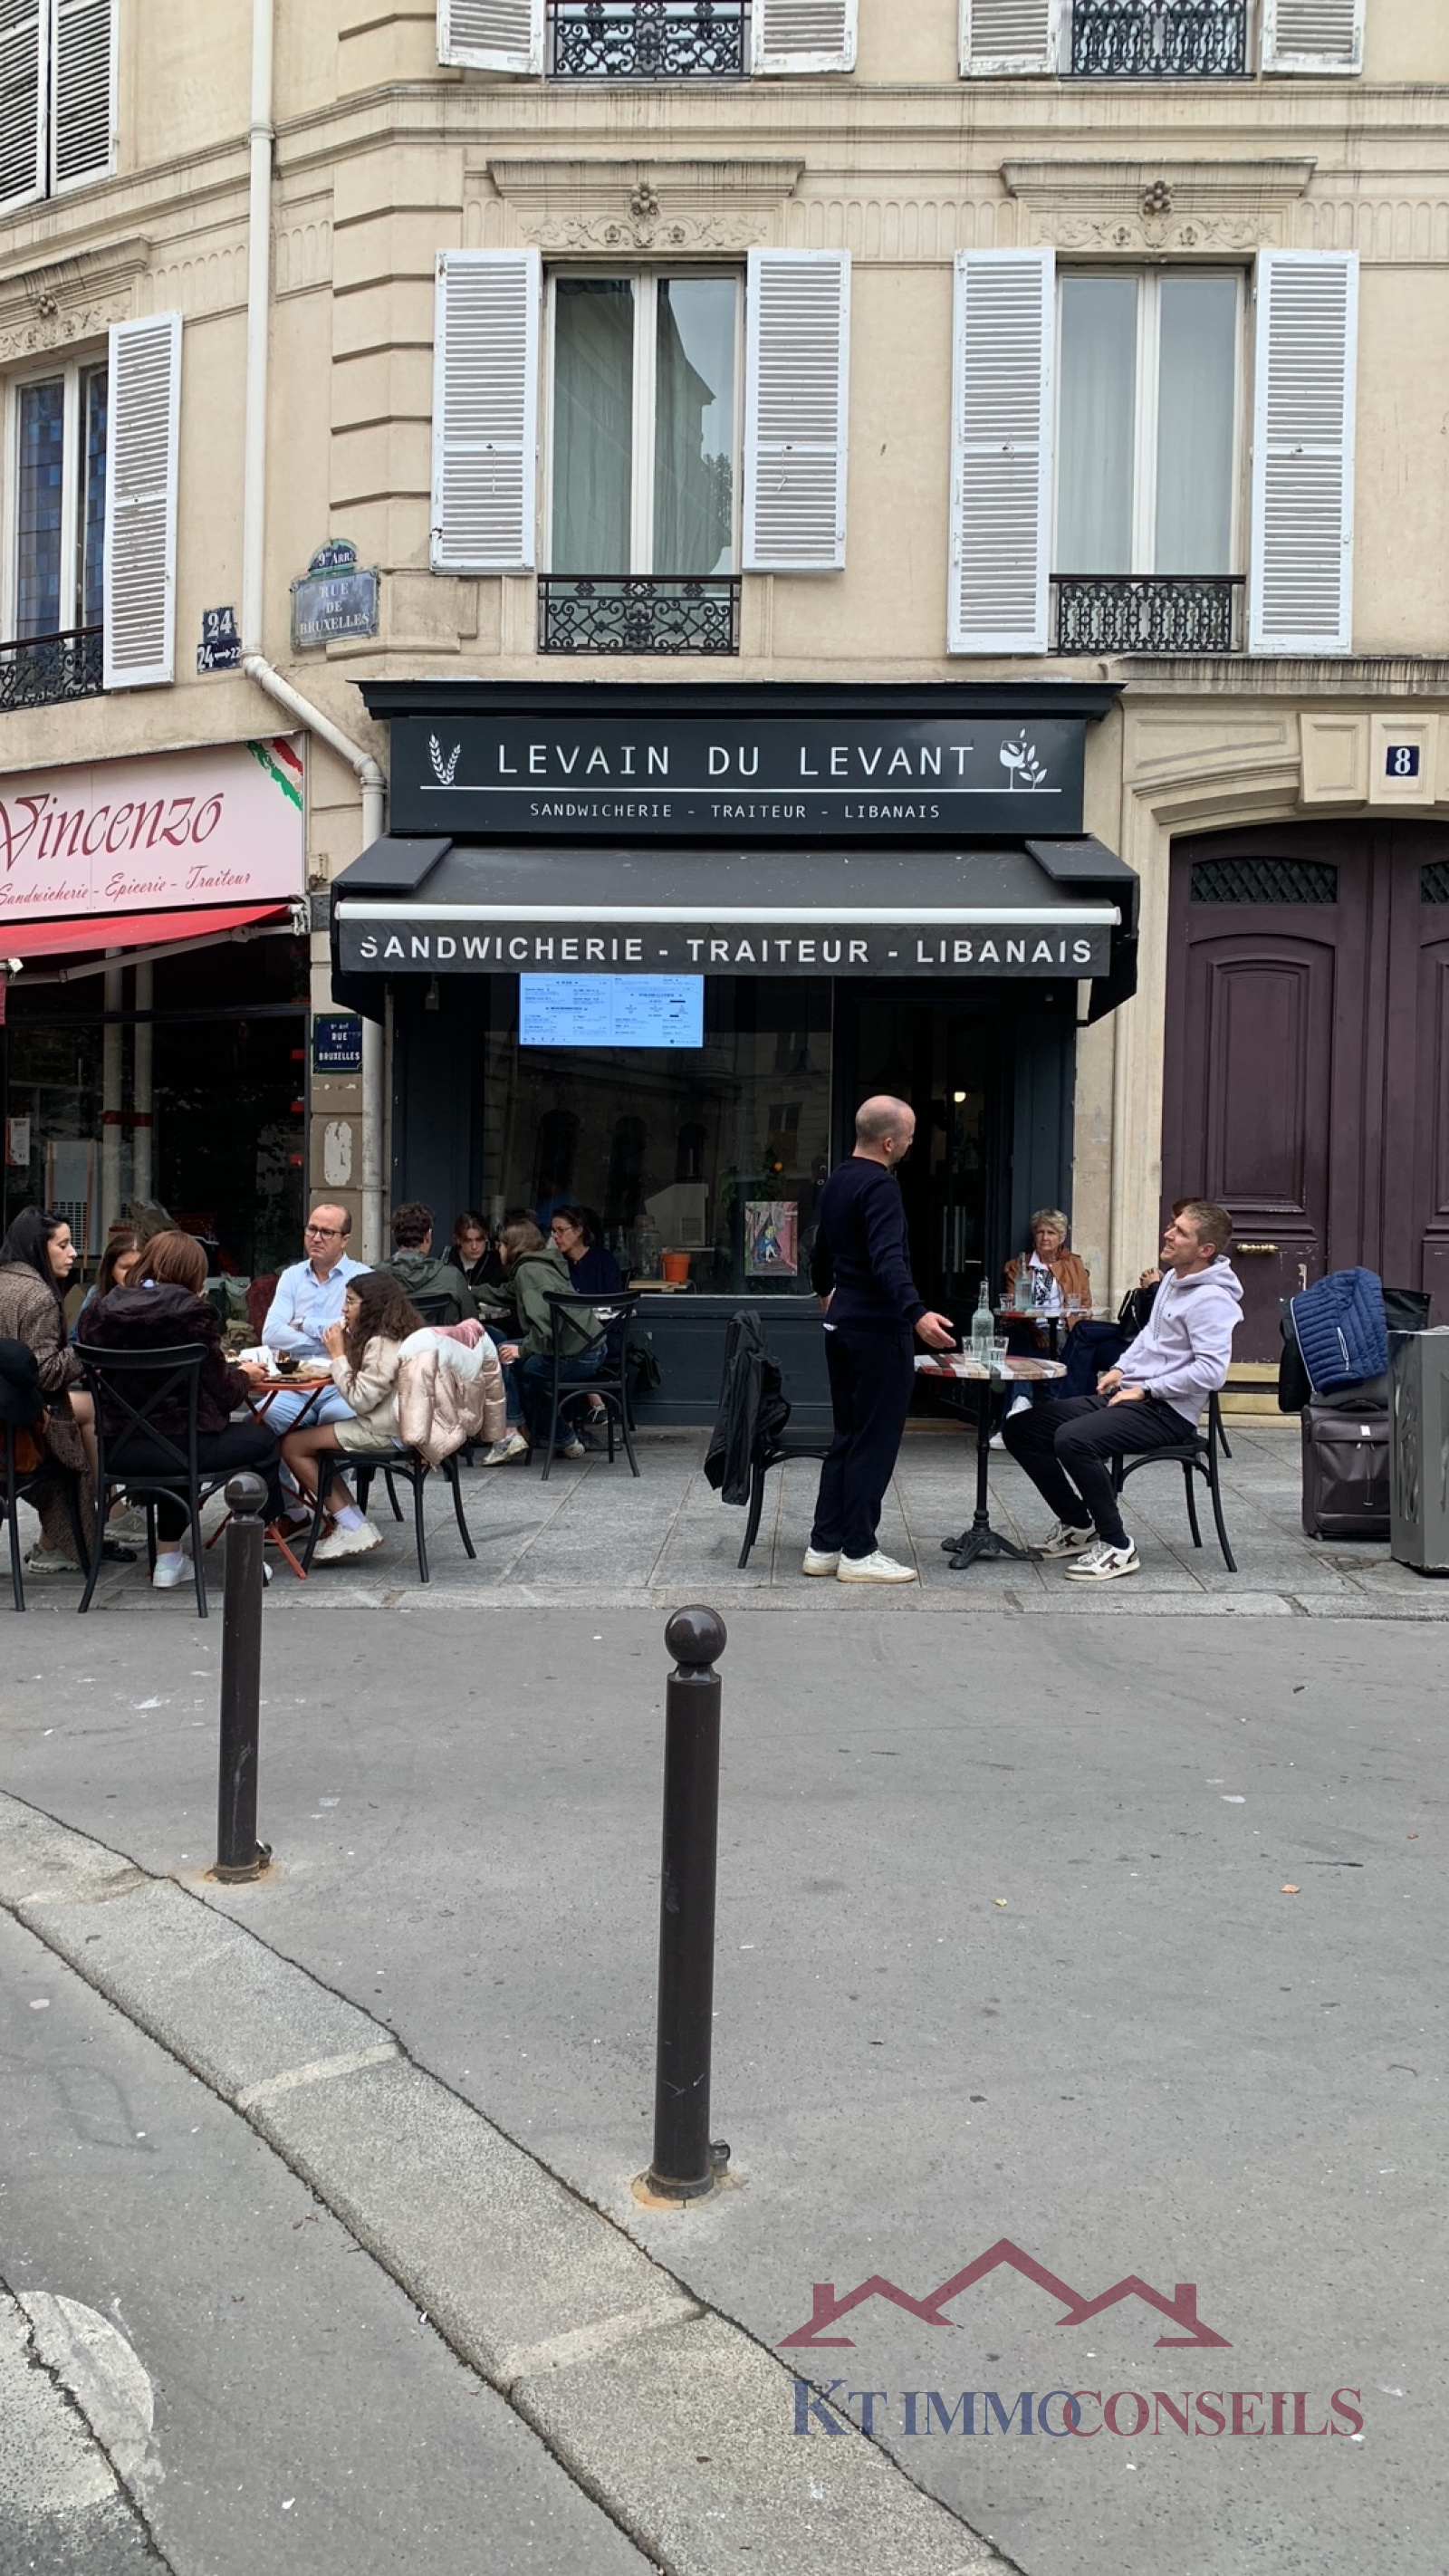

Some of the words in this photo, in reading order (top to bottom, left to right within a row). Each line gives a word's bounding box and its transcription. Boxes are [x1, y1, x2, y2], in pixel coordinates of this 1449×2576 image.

[320, 582, 349, 598] RUE
[326, 601, 343, 614] DE
[206, 610, 232, 638] 24
[300, 612, 369, 634] BRUXELLES
[197, 645, 214, 668] 24
[498, 745, 669, 775] LEVAIN
[708, 746, 759, 775] DU
[800, 746, 974, 775] LEVANT
[1395, 748, 1411, 774] 8
[530, 803, 672, 818] SANDWICHERIE
[711, 804, 807, 818] TRAITEUR
[844, 804, 941, 818] LIBANAIS
[0, 880, 89, 906] Sandwicherie
[105, 872, 167, 902] Epicerie
[186, 865, 252, 890] Traiteur
[360, 936, 643, 961] SANDWICHERIE
[686, 938, 869, 963] TRAITEUR
[916, 939, 1091, 964] LIBANAIS
[319, 1051, 360, 1061] BRUXELLES
